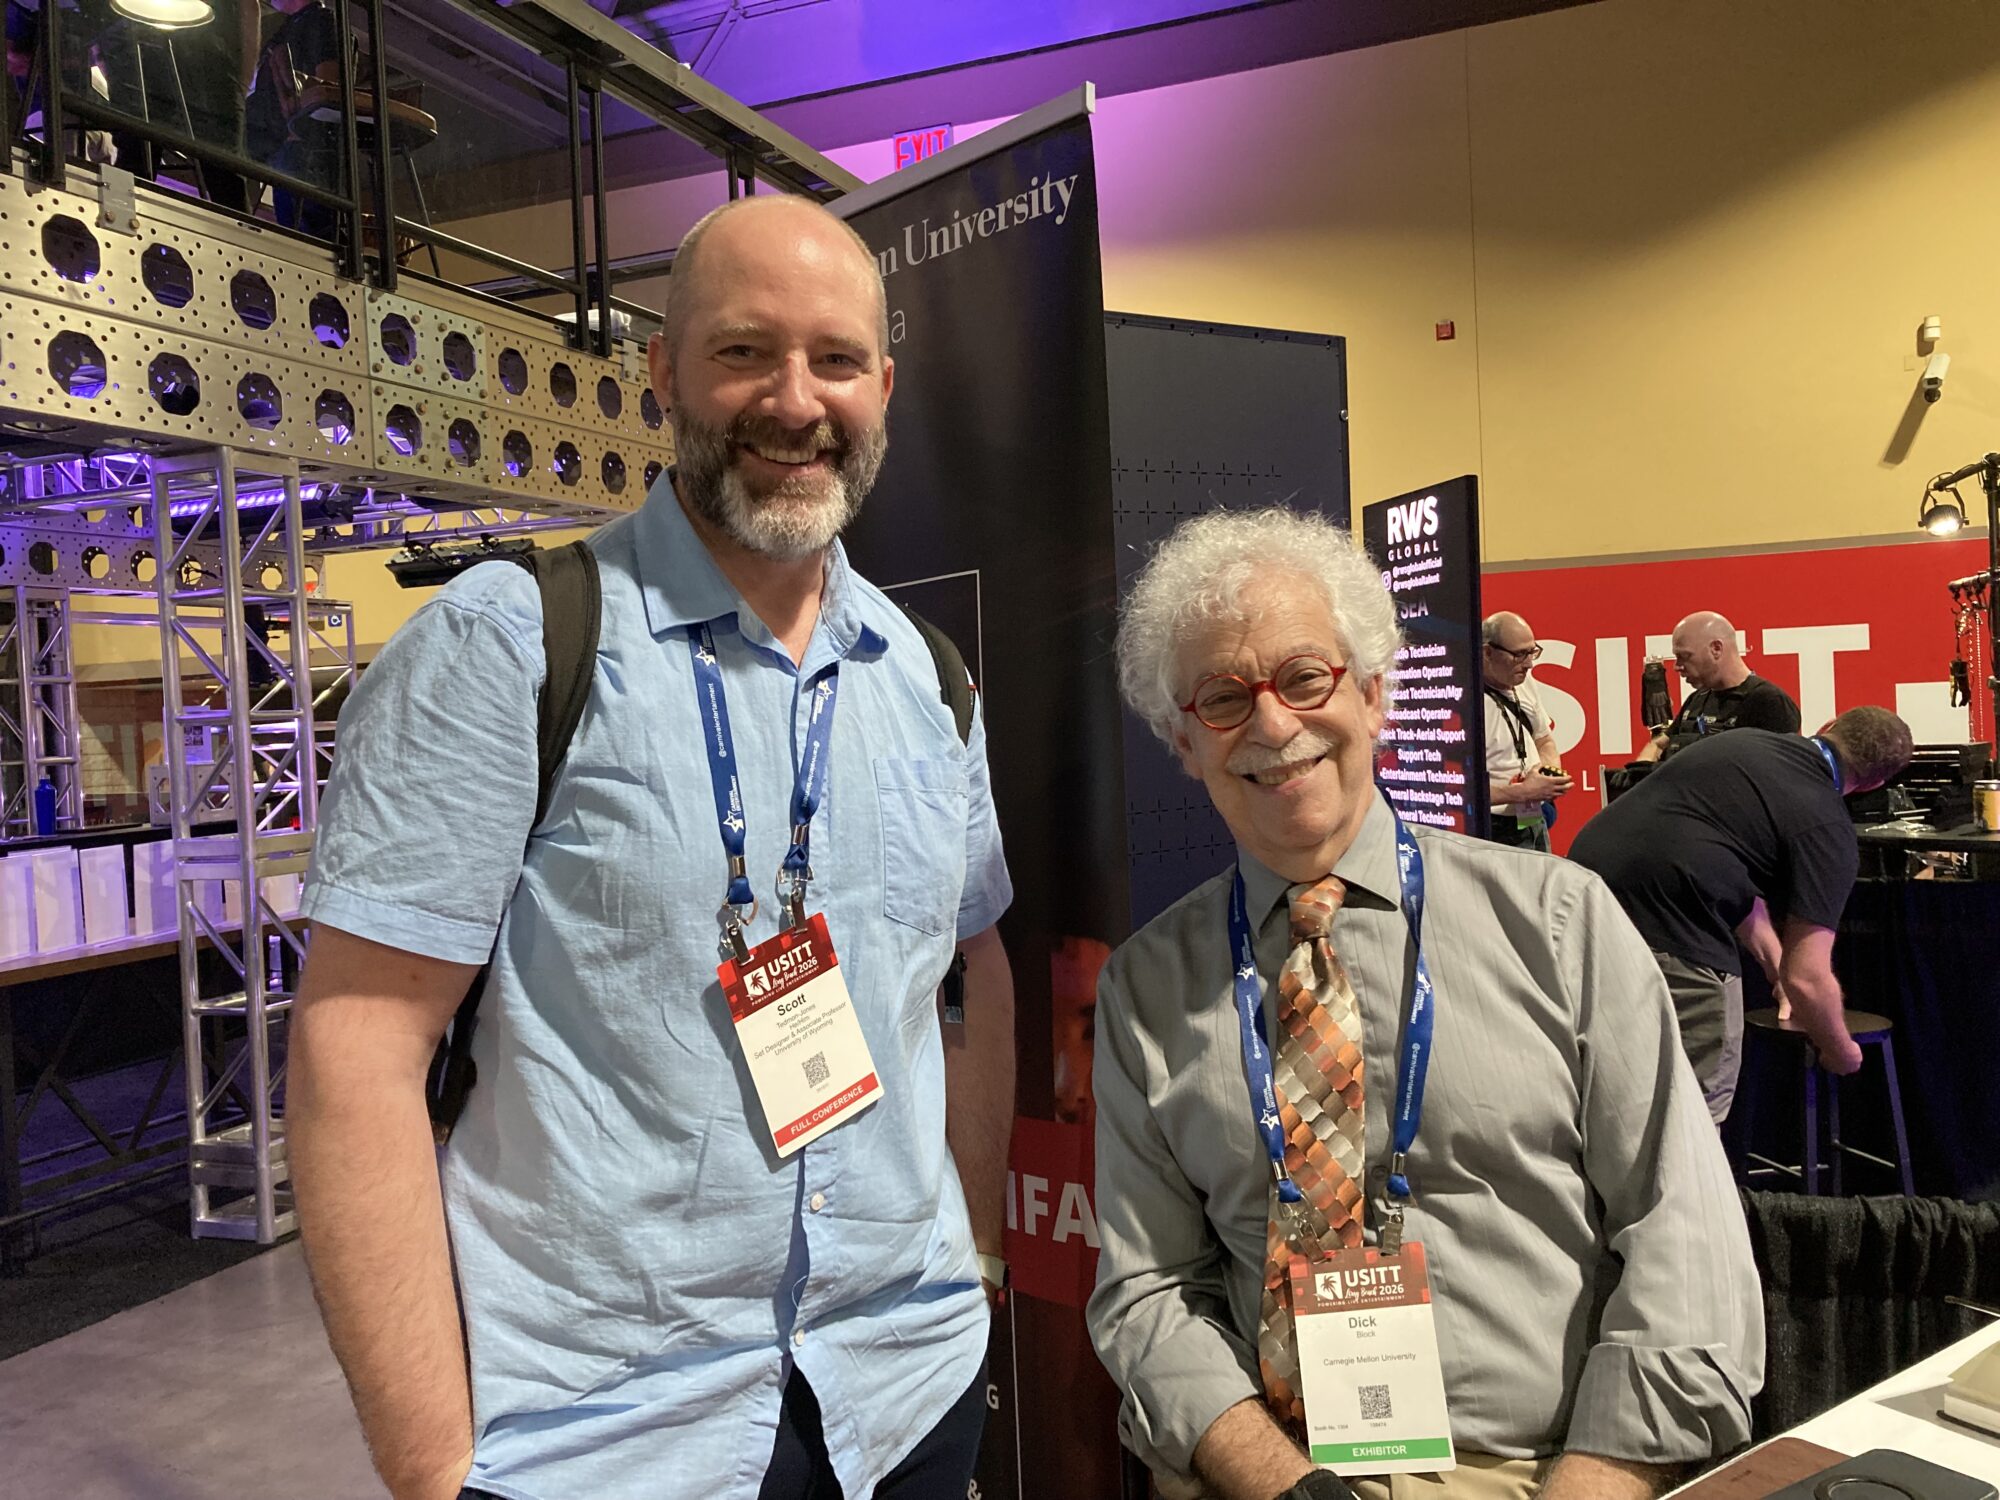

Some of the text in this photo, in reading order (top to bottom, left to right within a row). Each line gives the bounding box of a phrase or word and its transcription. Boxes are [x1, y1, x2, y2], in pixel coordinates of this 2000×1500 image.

[903, 171, 1078, 266] University
[1387, 496, 1439, 545] RWS
[1388, 539, 1439, 561] GLOBAL
[1392, 556, 1442, 578] @rwsglobalofficial
[1409, 644, 1447, 658] Technician
[1422, 666, 1453, 680] Operator
[1410, 685, 1463, 701] Technician/Mgr
[1421, 707, 1452, 722] Operator
[1396, 728, 1435, 741] Track-Aerial
[1436, 728, 1466, 744] Support
[1397, 748, 1441, 763] Support Tech
[1427, 770, 1465, 784] Technician
[1410, 789, 1444, 807] Backstage
[1445, 792, 1463, 806] Tech
[1418, 810, 1455, 826] Technician
[767, 940, 812, 977] USITT
[798, 956, 818, 973] 2026
[777, 993, 806, 1016] Scott
[764, 1035, 790, 1053] Designer
[796, 1017, 822, 1035] Associate
[822, 1002, 847, 1018] Professor
[774, 1018, 833, 1056] University of Wyoming
[791, 1085, 864, 1135] FULL CONFERENCE
[1344, 1265, 1401, 1287] USITT
[1379, 1284, 1405, 1296] 2026
[1348, 1316, 1377, 1329] Dick
[1356, 1330, 1376, 1339] Block
[1323, 1352, 1416, 1366] Carnegie Mellon University
[1352, 1445, 1408, 1457] EXHIBITOR
